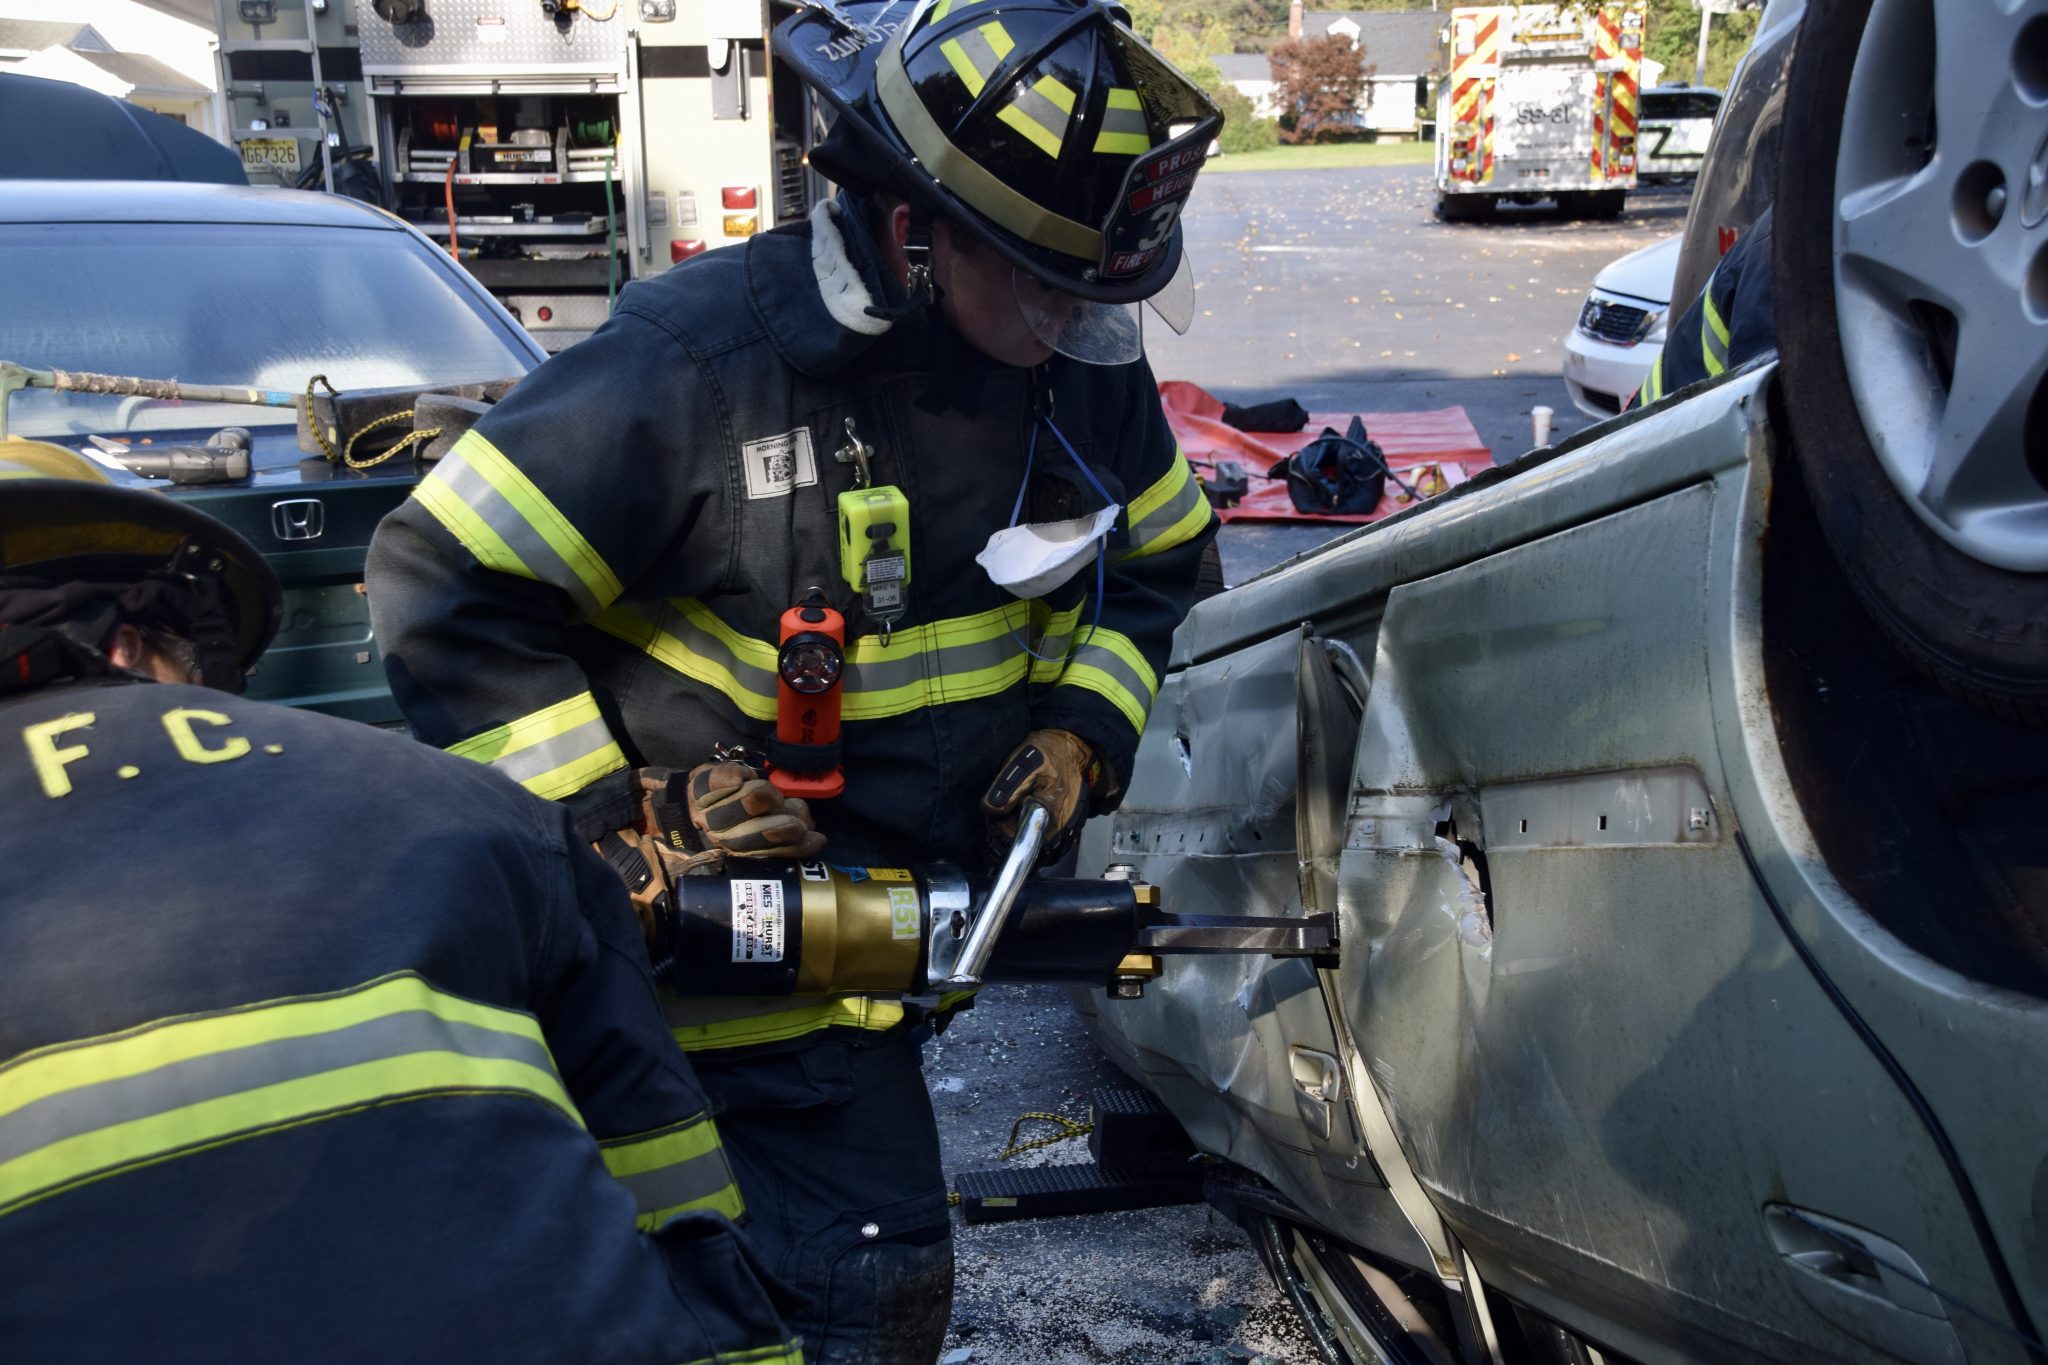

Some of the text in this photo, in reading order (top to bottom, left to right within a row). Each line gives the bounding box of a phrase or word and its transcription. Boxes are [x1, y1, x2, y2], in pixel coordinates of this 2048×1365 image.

[756, 440, 789, 453] MORNING
[763, 885, 773, 908] MES
[892, 889, 917, 937] R51
[764, 920, 773, 957] HURST
